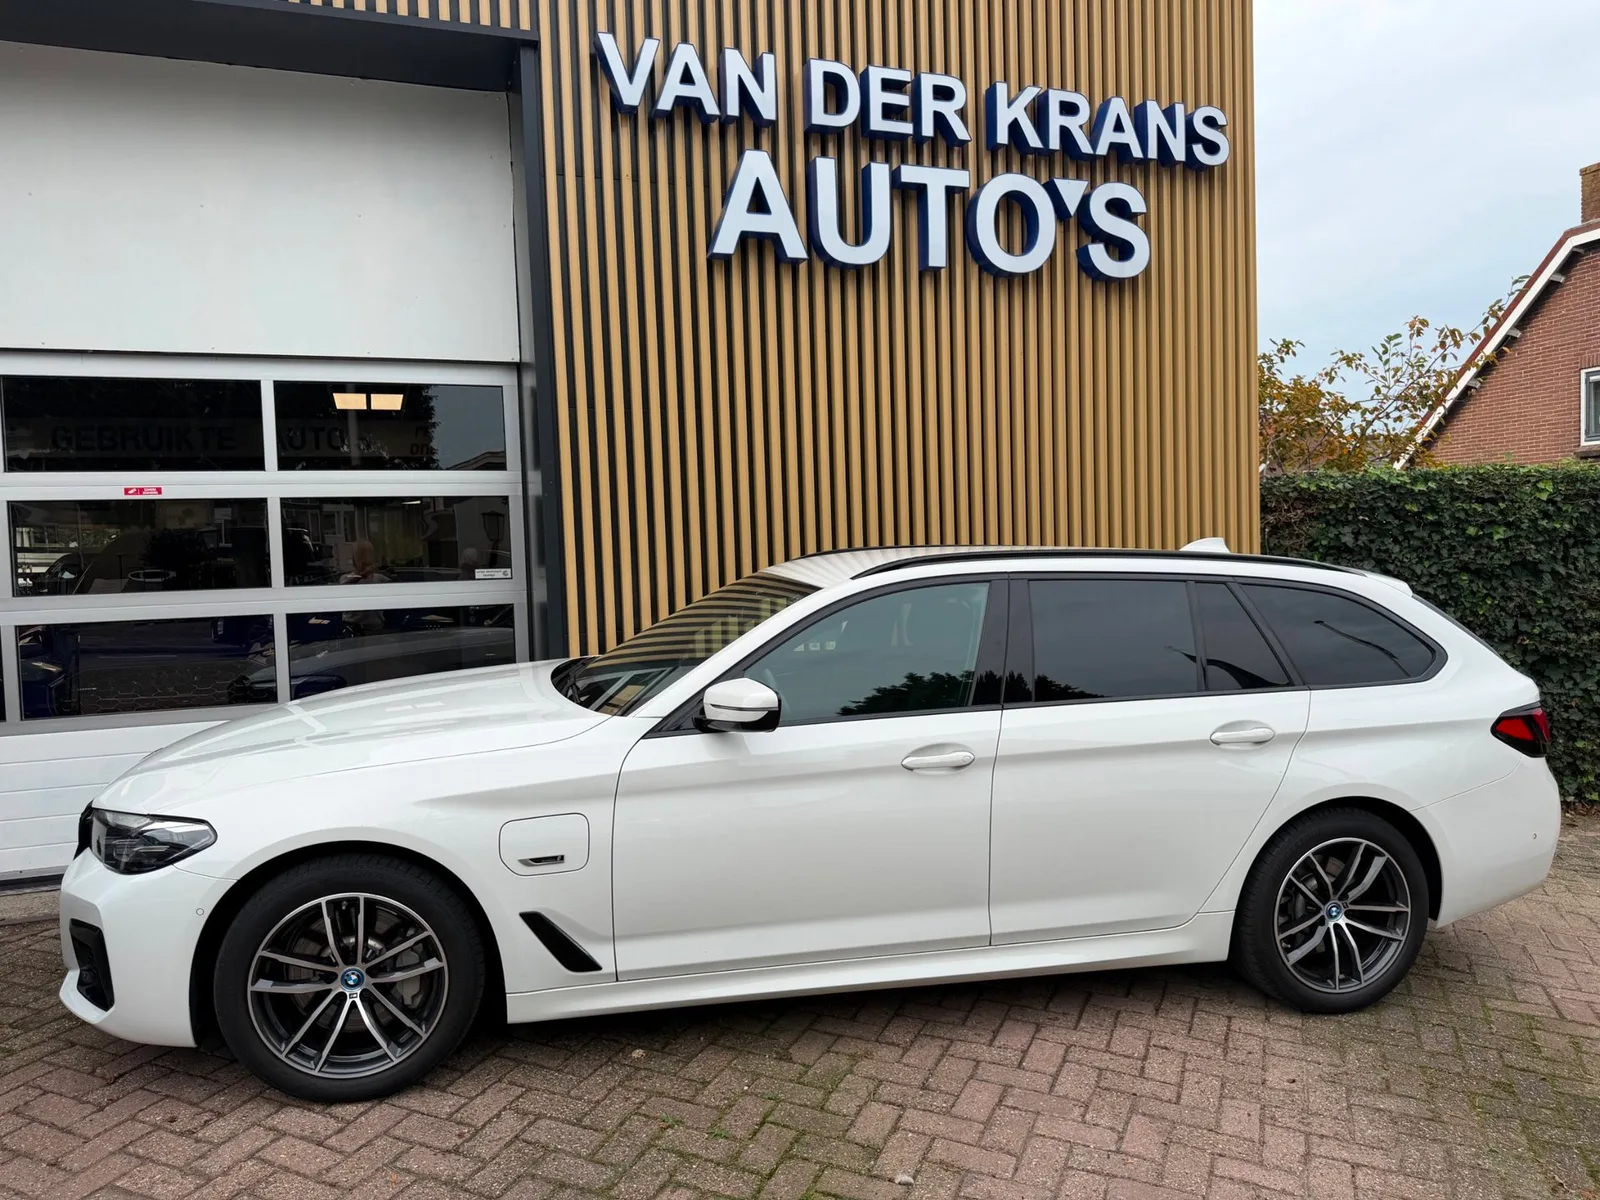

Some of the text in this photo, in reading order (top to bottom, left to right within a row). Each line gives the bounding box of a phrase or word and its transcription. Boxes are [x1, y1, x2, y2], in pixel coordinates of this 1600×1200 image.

[597, 32, 1231, 167] VAN DER KRANS
[708, 149, 1151, 279] AUTO'S
[50, 425, 236, 451] GEBRUIKTE
